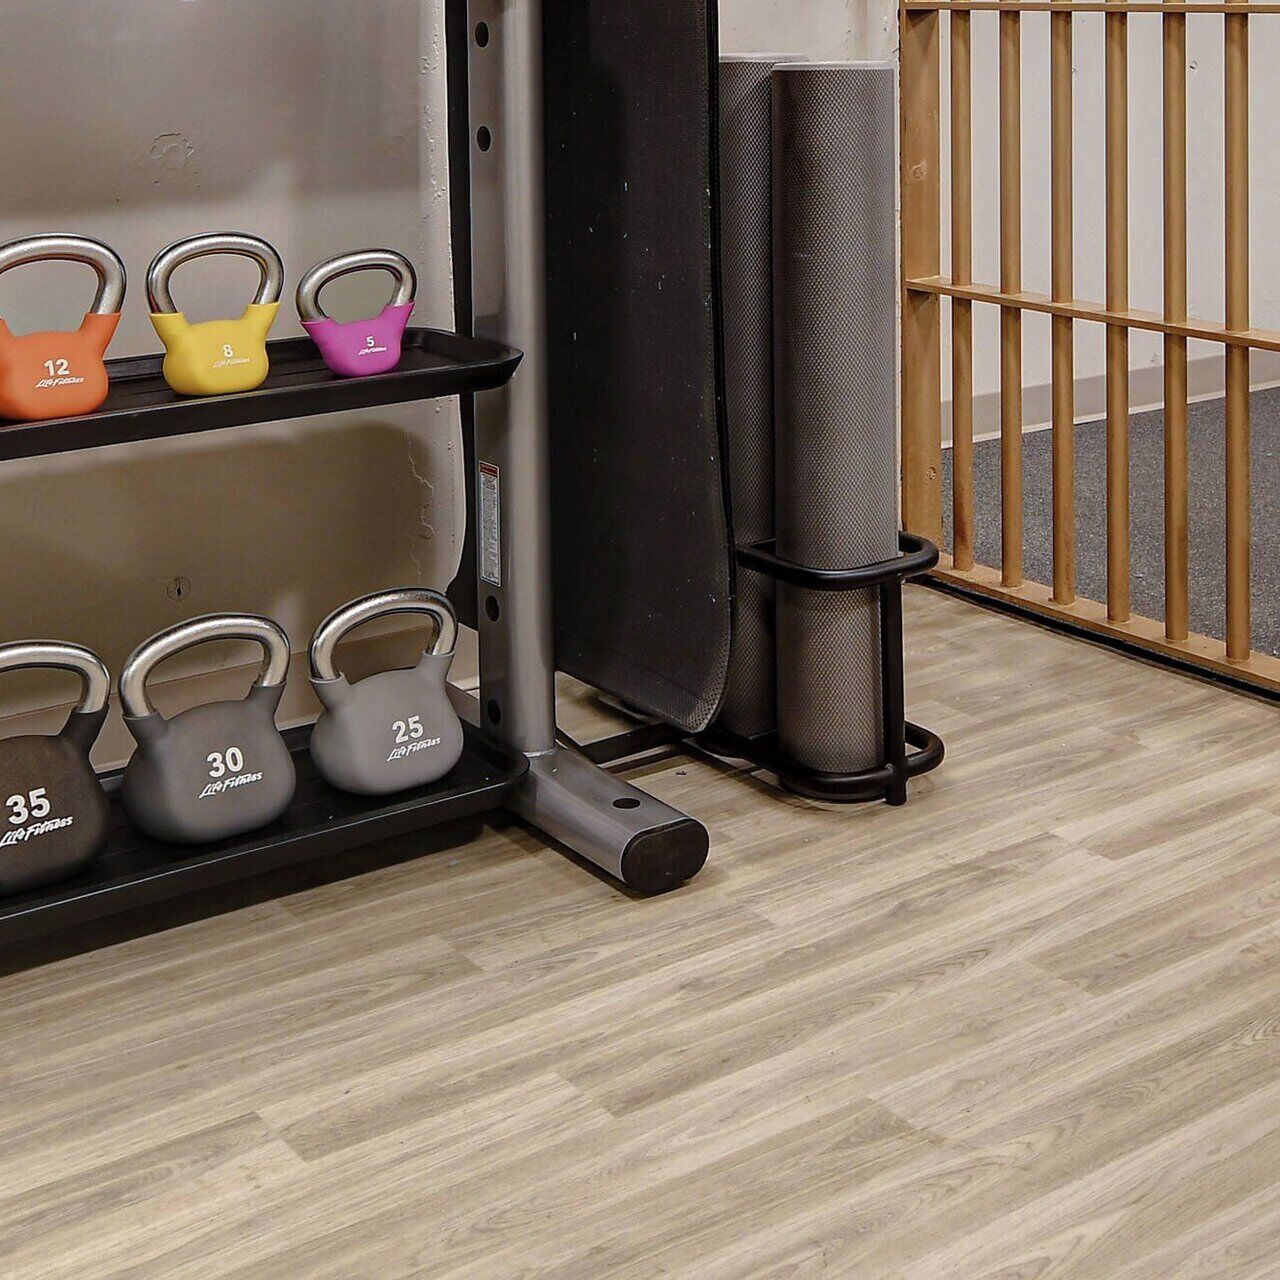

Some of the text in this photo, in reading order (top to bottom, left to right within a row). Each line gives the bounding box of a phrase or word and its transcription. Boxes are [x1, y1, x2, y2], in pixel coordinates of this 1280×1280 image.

[222, 344, 234, 357] 8
[365, 335, 375, 348] 5
[43, 358, 71, 377] 12
[391, 714, 424, 744] 25
[206, 746, 244, 778] 30
[5, 786, 51, 825] 35
